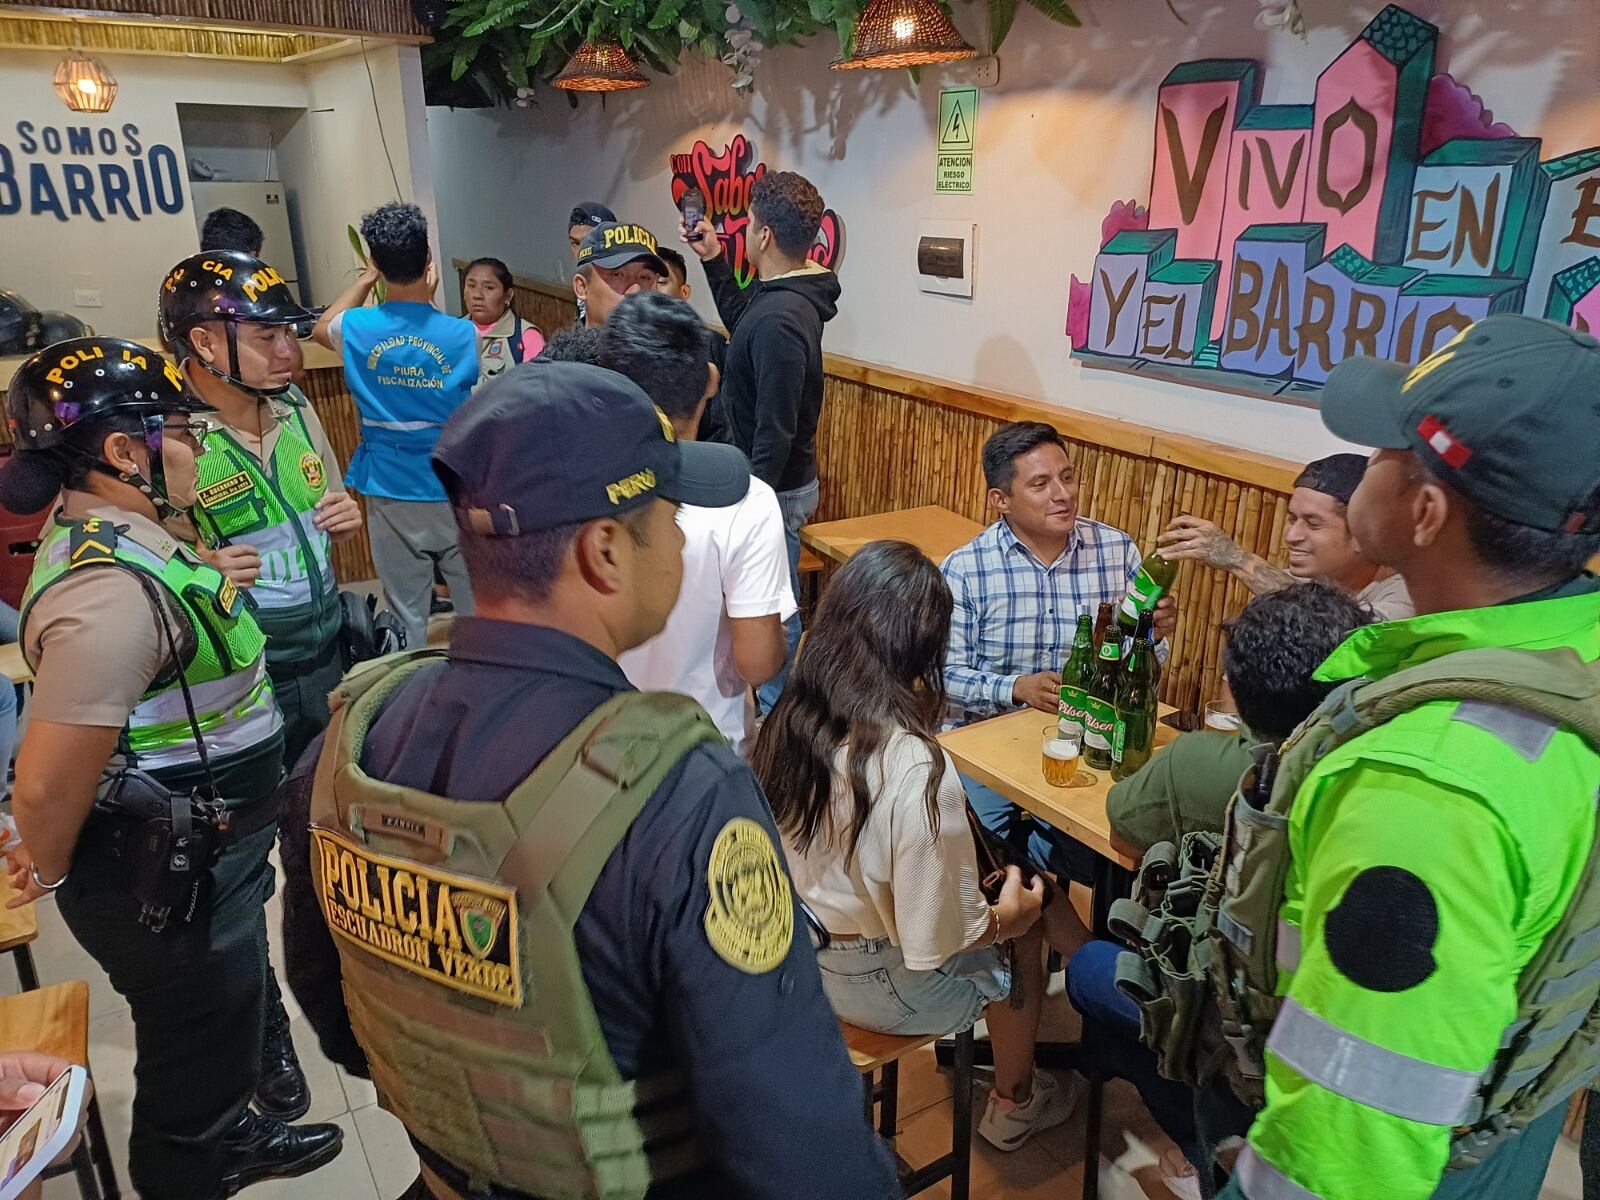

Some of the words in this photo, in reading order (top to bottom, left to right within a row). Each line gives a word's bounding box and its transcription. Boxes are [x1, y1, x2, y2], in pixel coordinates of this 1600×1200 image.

[16, 120, 143, 156] SOMOS
[938, 157, 971, 167] ATENCION
[943, 171, 965, 179] RIESGO
[1160, 96, 1377, 226] VIVO
[1406, 172, 1500, 269] EN
[604, 224, 658, 256] POLICIA
[393, 365, 425, 377] PIURA
[324, 840, 463, 951] POLICIA
[329, 901, 431, 969] ESCUADRON
